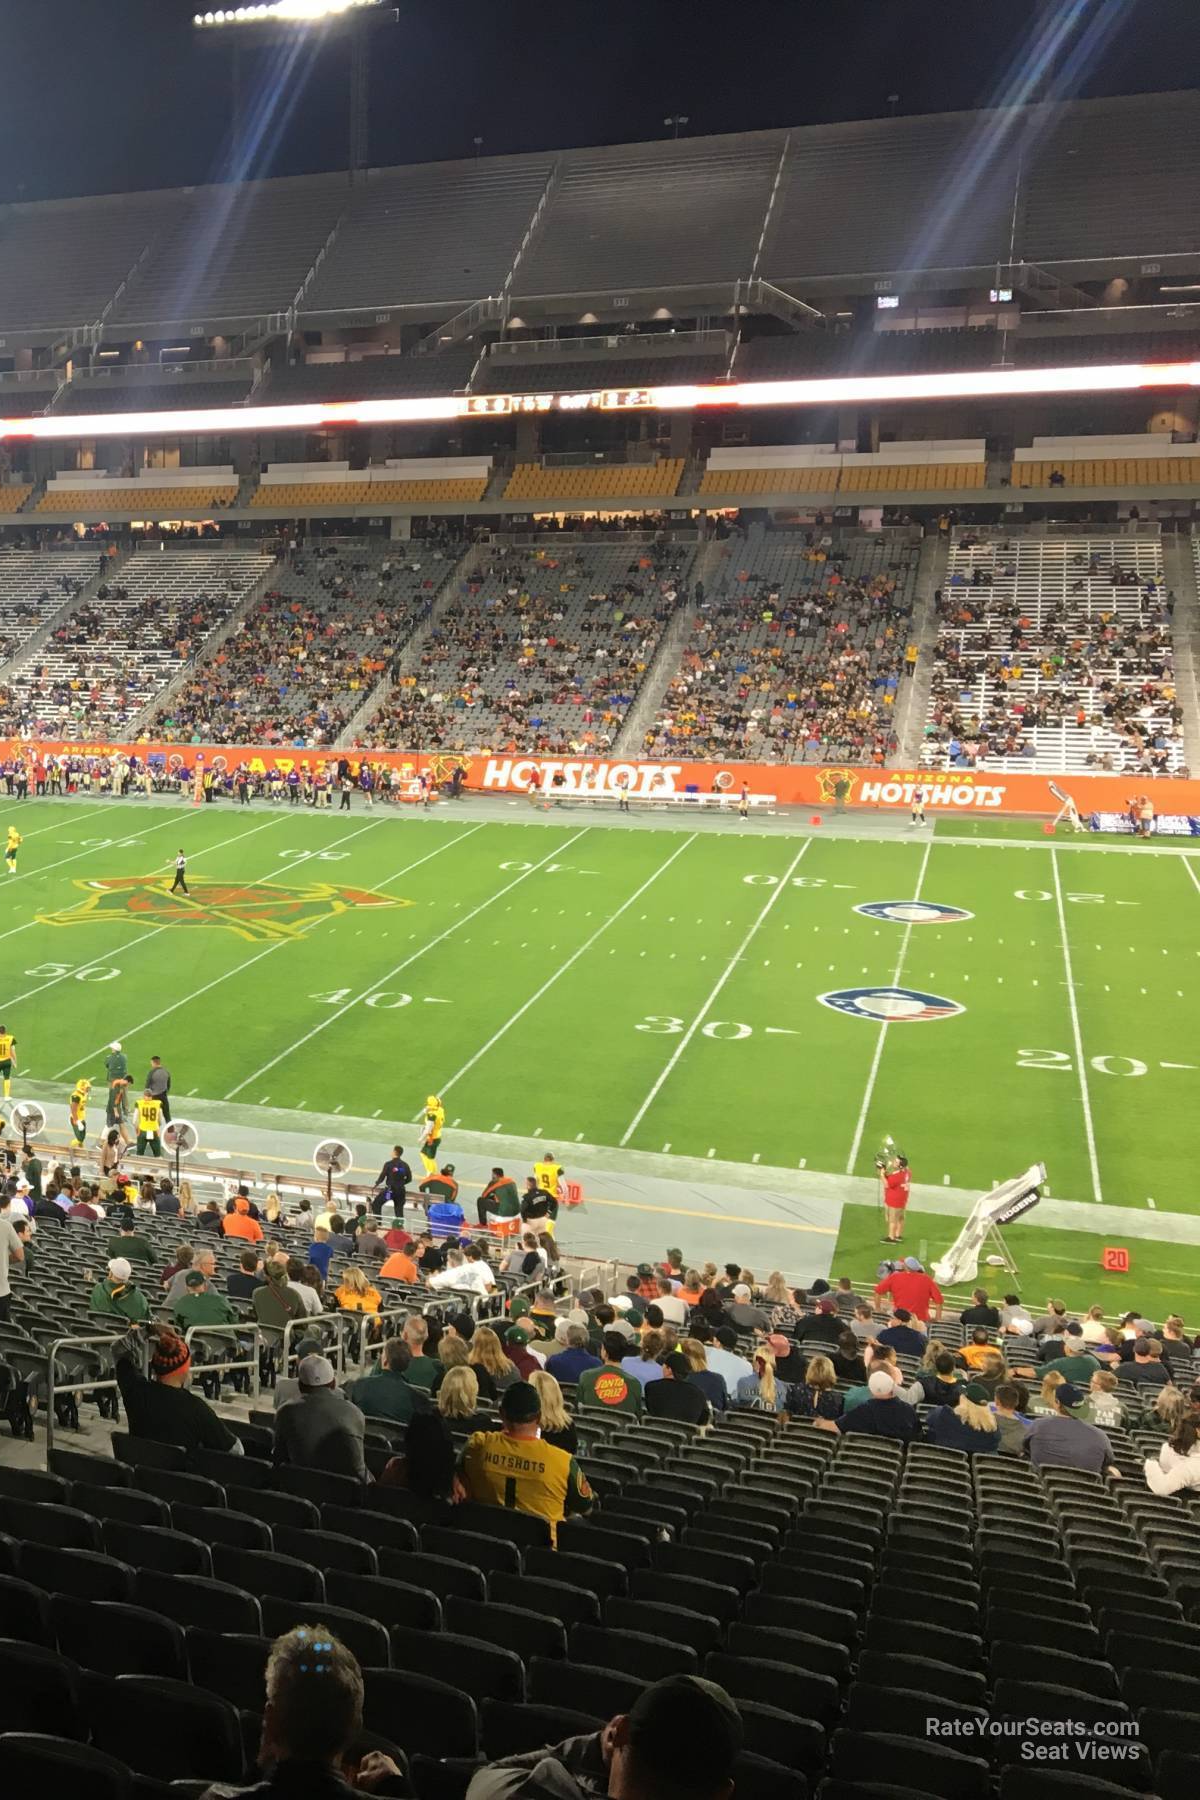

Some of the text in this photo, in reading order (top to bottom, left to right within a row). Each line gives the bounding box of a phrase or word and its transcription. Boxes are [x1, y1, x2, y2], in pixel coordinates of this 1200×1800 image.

[483, 760, 682, 795] HOTSHOTS
[890, 773, 974, 784] ARIZONA
[860, 782, 1006, 806] HOTSHOTS
[634, 1015, 754, 1040] 30
[1015, 1049, 1148, 1077] 20
[142, 1107, 157, 1122] 48
[1108, 1250, 1126, 1268] 20
[594, 1378, 625, 1390] SANTA
[598, 1388, 622, 1399] CRUZ
[484, 1452, 546, 1474] HOTSHOTS
